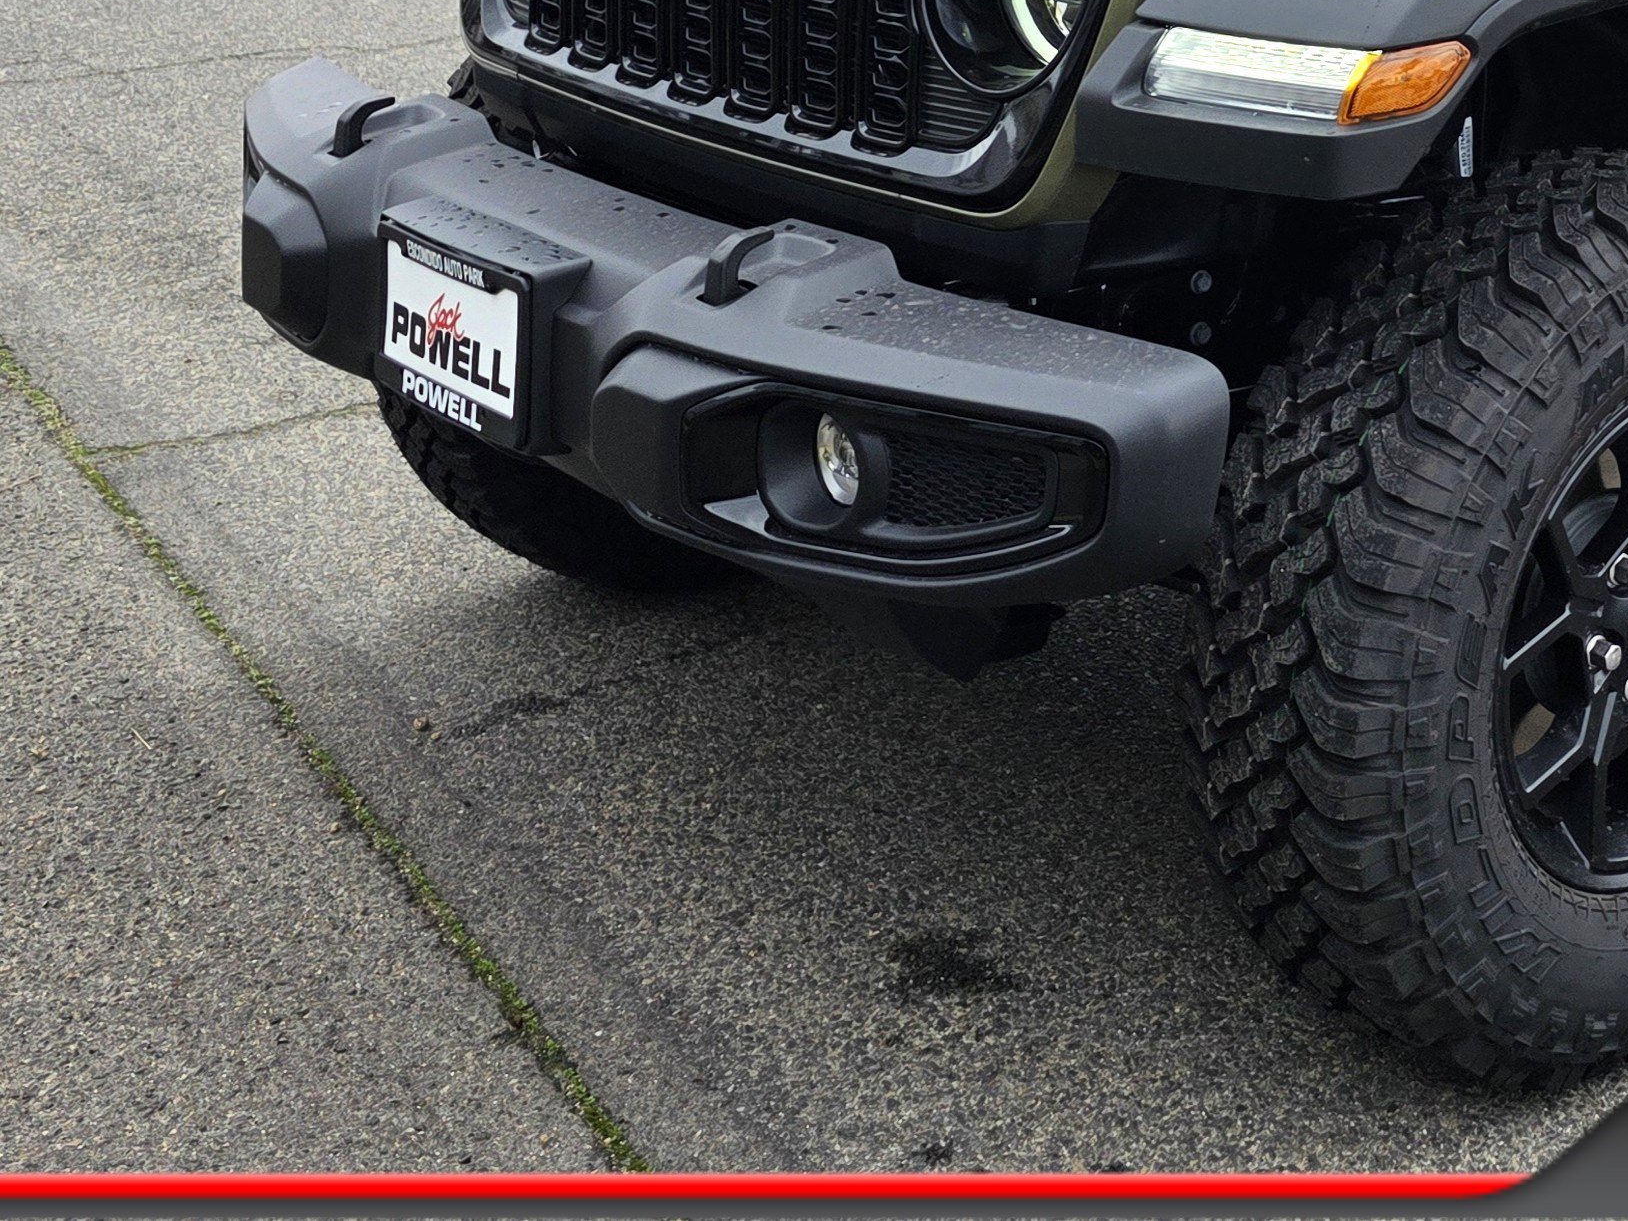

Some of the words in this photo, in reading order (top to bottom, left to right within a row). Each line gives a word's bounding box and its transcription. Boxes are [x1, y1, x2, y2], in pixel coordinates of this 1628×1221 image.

[406, 239, 442, 275] ESCONDIDO
[444, 256, 462, 280] AUTO
[463, 264, 485, 288] PARK
[427, 292, 465, 346] Jack
[392, 301, 510, 399] POWELL
[402, 369, 482, 432] POWELL
